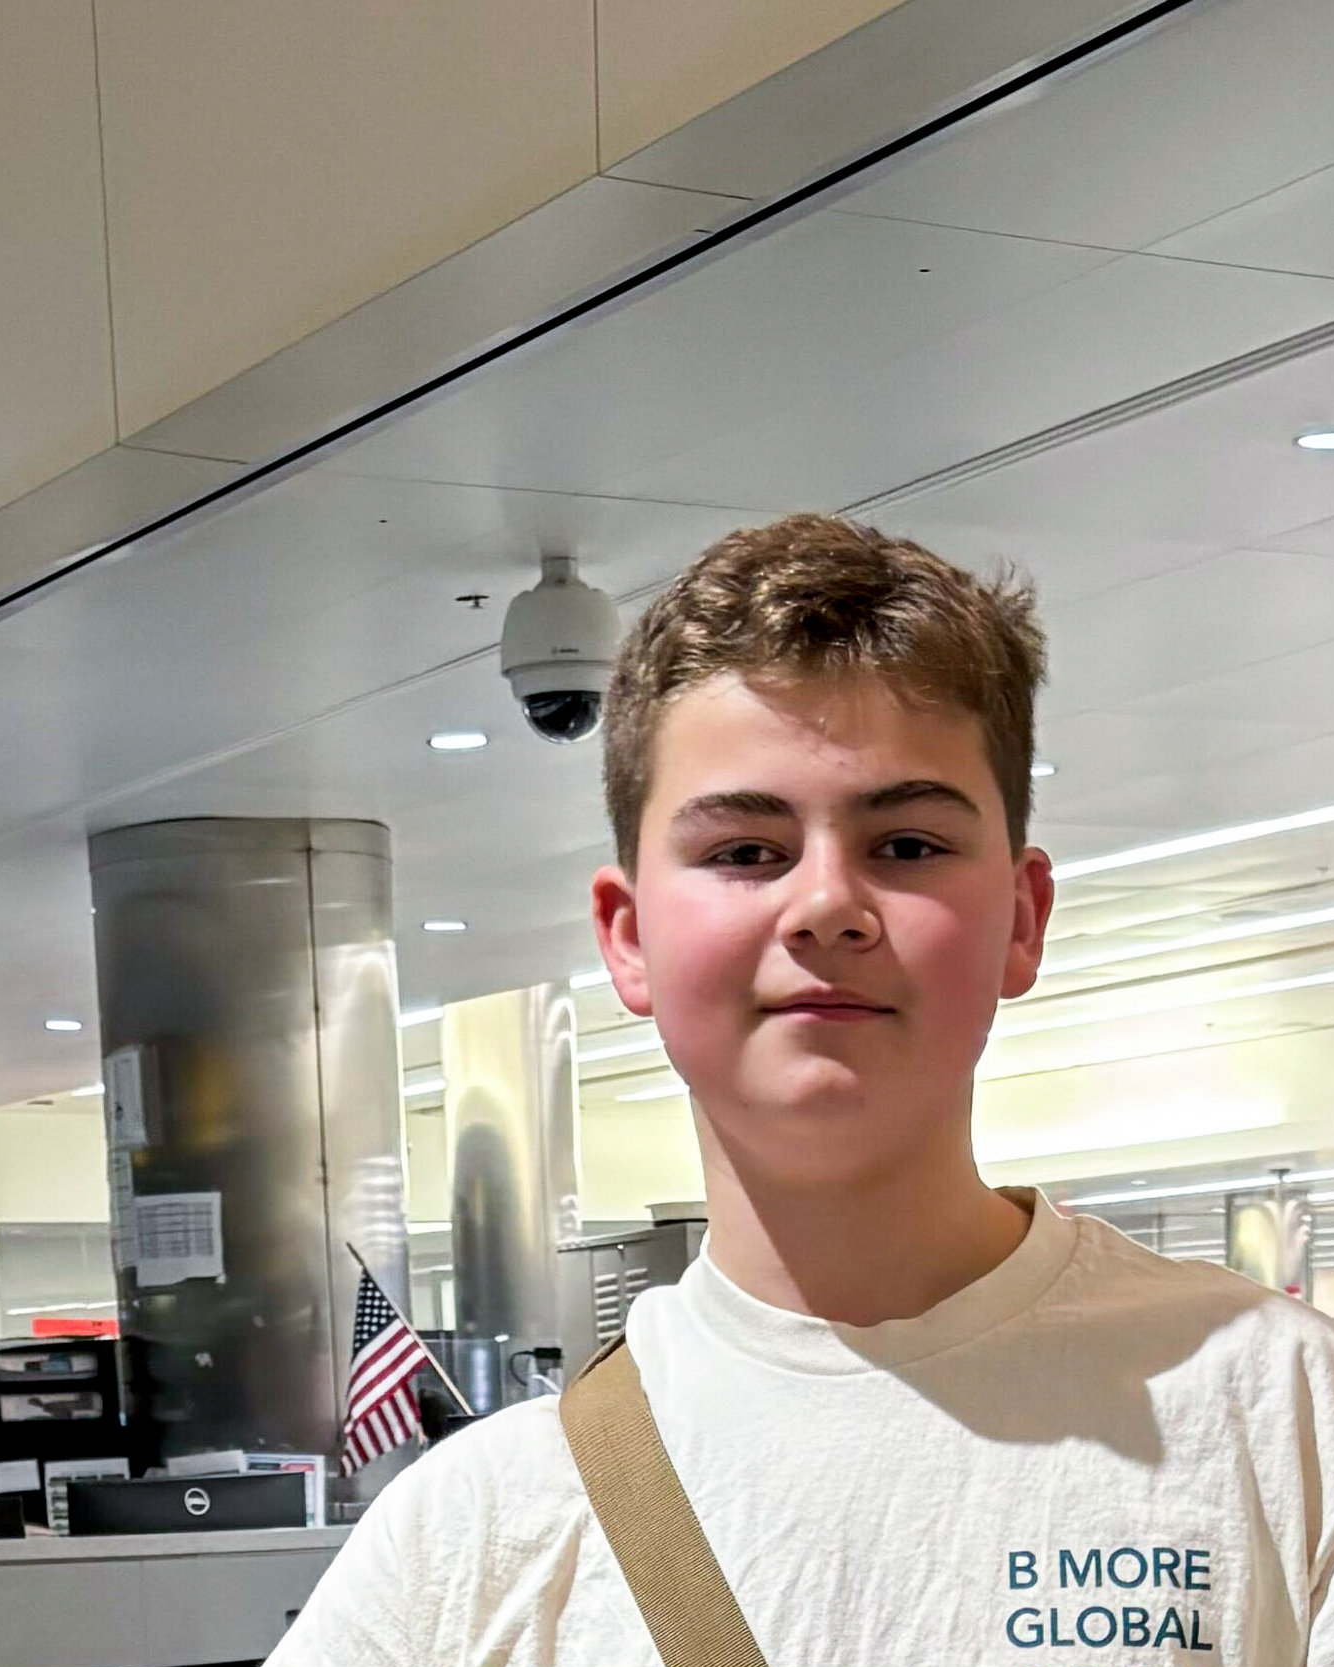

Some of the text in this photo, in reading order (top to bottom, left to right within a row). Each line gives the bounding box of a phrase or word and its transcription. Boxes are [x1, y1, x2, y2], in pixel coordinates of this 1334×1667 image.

[1008, 1547, 1211, 1591] B MORE
[1005, 1605, 1213, 1651] GLOBAL
